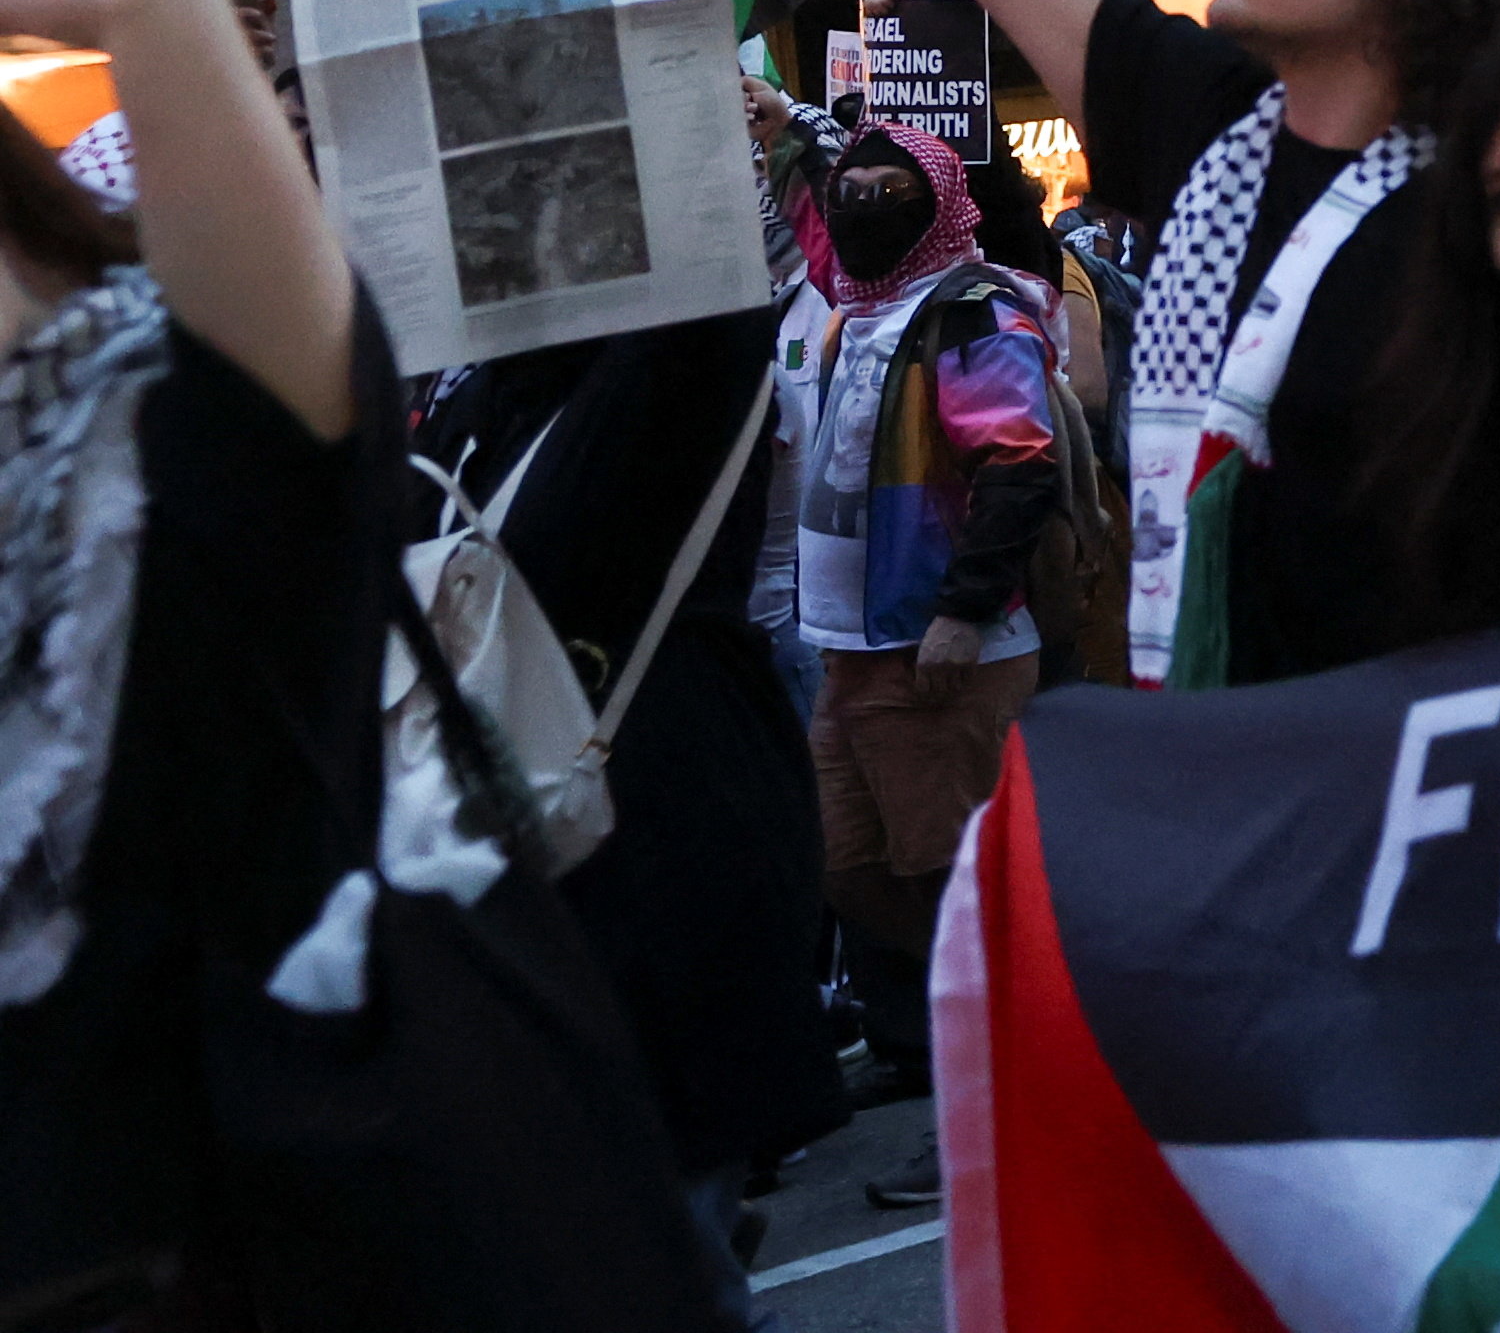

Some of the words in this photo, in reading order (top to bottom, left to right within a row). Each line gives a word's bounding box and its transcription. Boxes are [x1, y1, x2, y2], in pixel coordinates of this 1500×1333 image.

[870, 49, 943, 74] DERING
[866, 81, 985, 106] OURNALISTS
[897, 113, 969, 138] TRUTH
